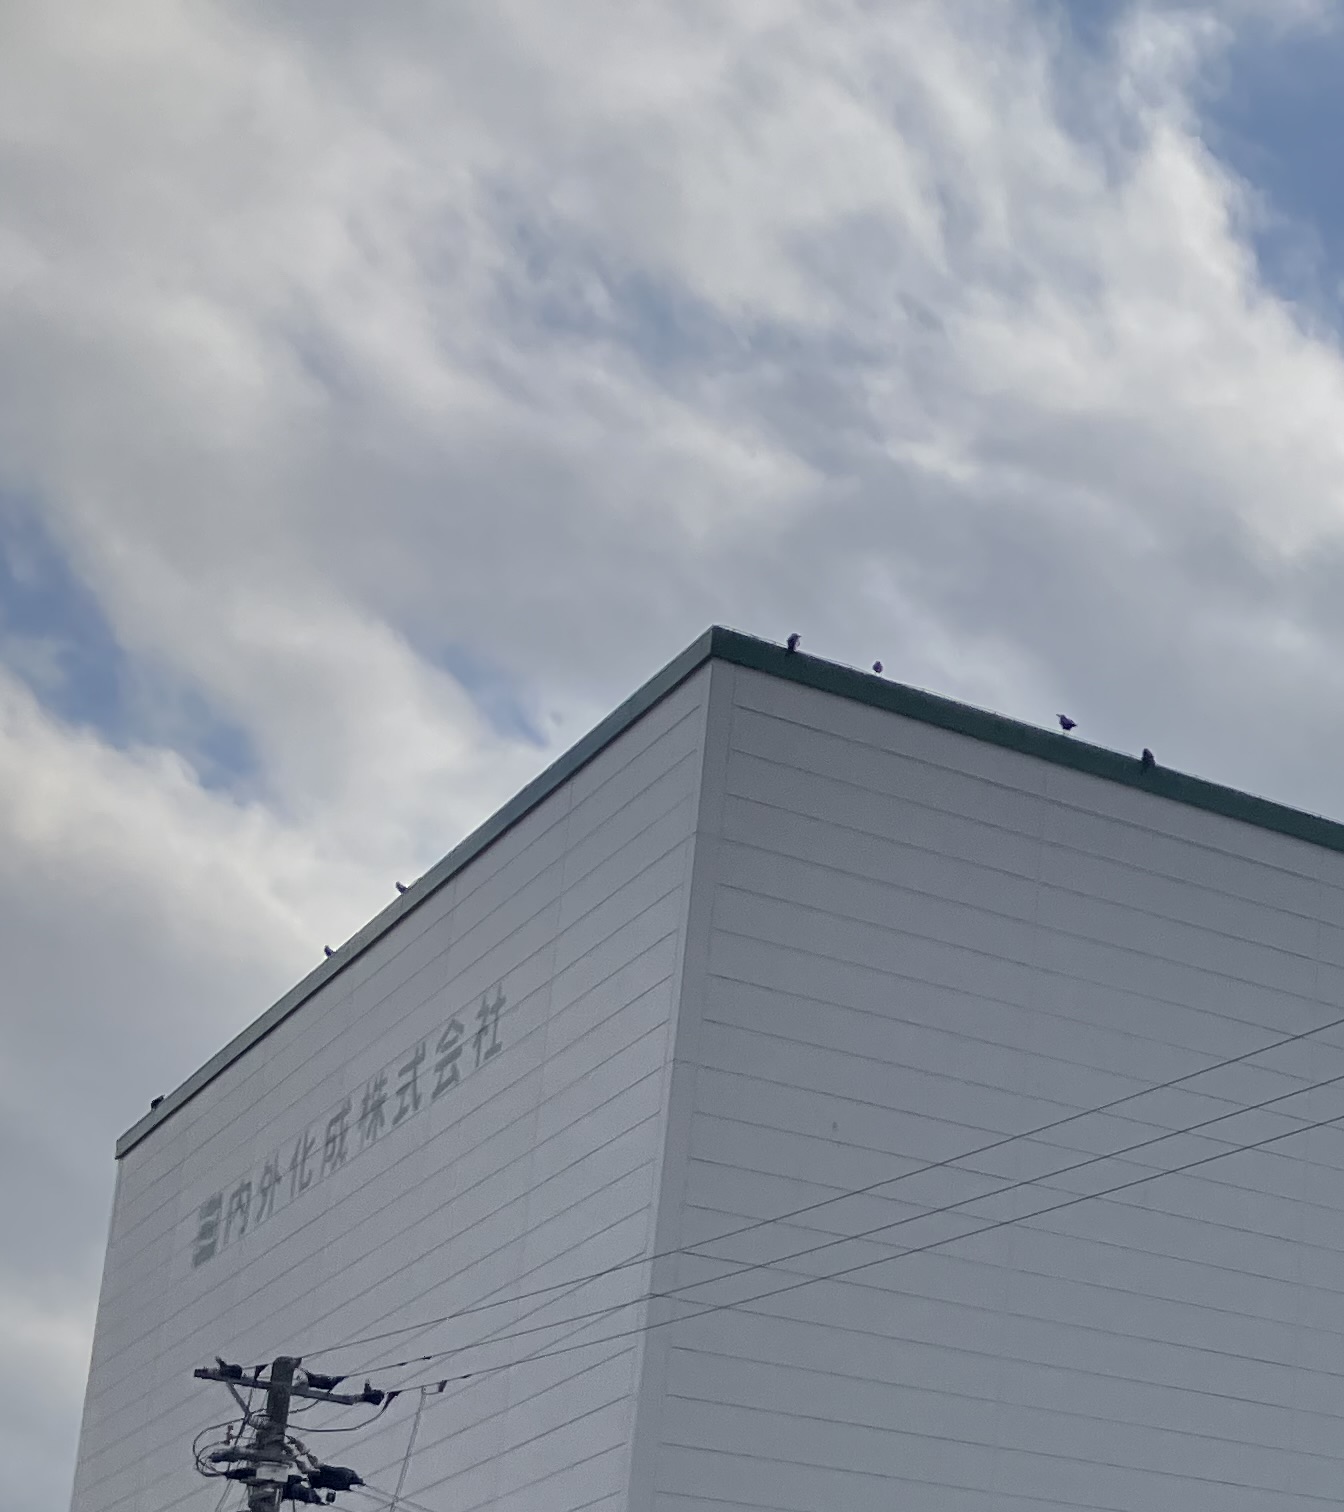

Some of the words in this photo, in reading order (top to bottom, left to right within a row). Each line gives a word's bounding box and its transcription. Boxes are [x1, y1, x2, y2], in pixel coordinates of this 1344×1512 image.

[223, 982, 507, 1248] 内外化成株式会社
